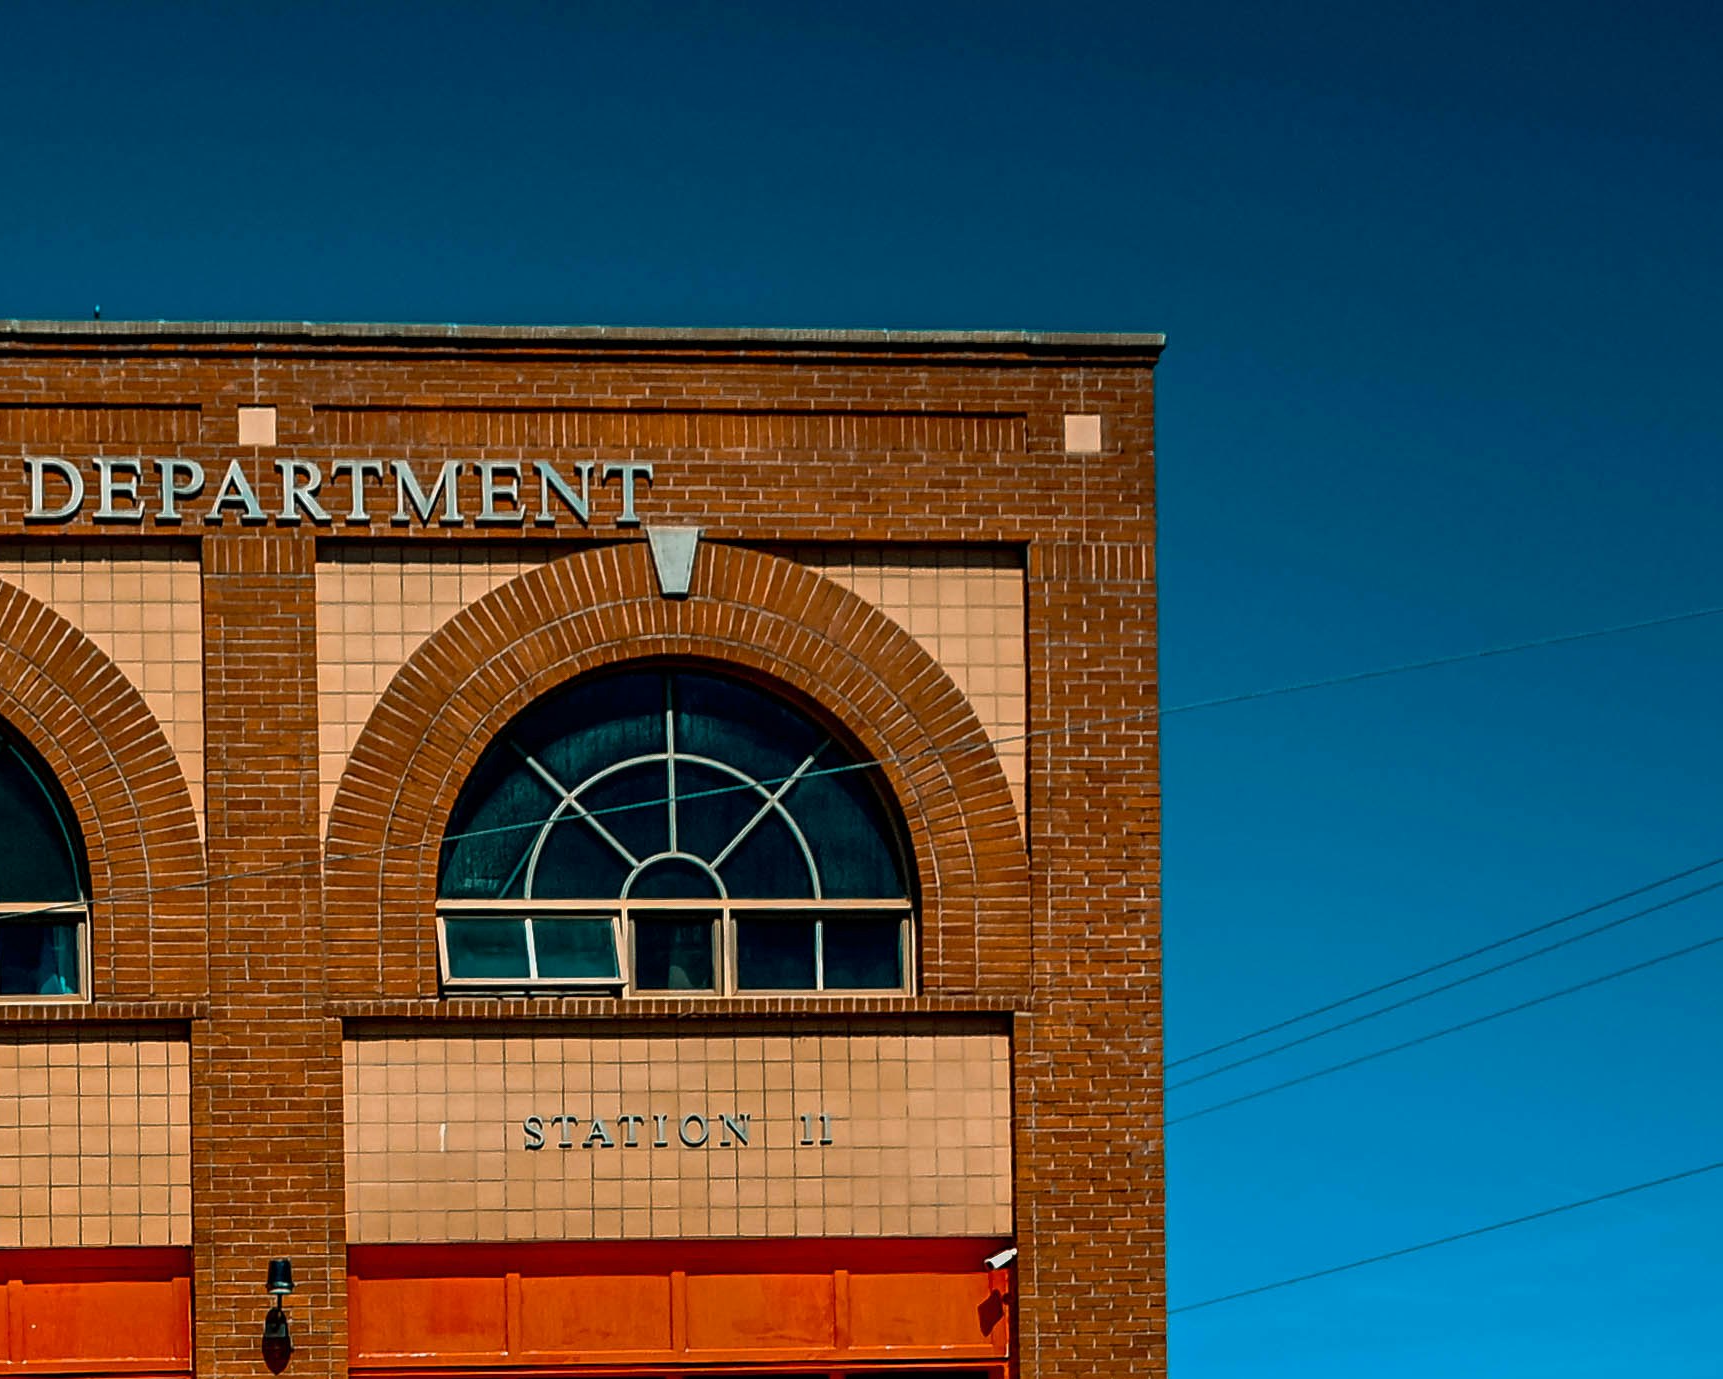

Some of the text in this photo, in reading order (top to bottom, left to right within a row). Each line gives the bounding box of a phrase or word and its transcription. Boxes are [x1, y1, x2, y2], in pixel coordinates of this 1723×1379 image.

[22, 457, 654, 526] DEPARTMENT
[522, 1113, 834, 1151] STATION 11
